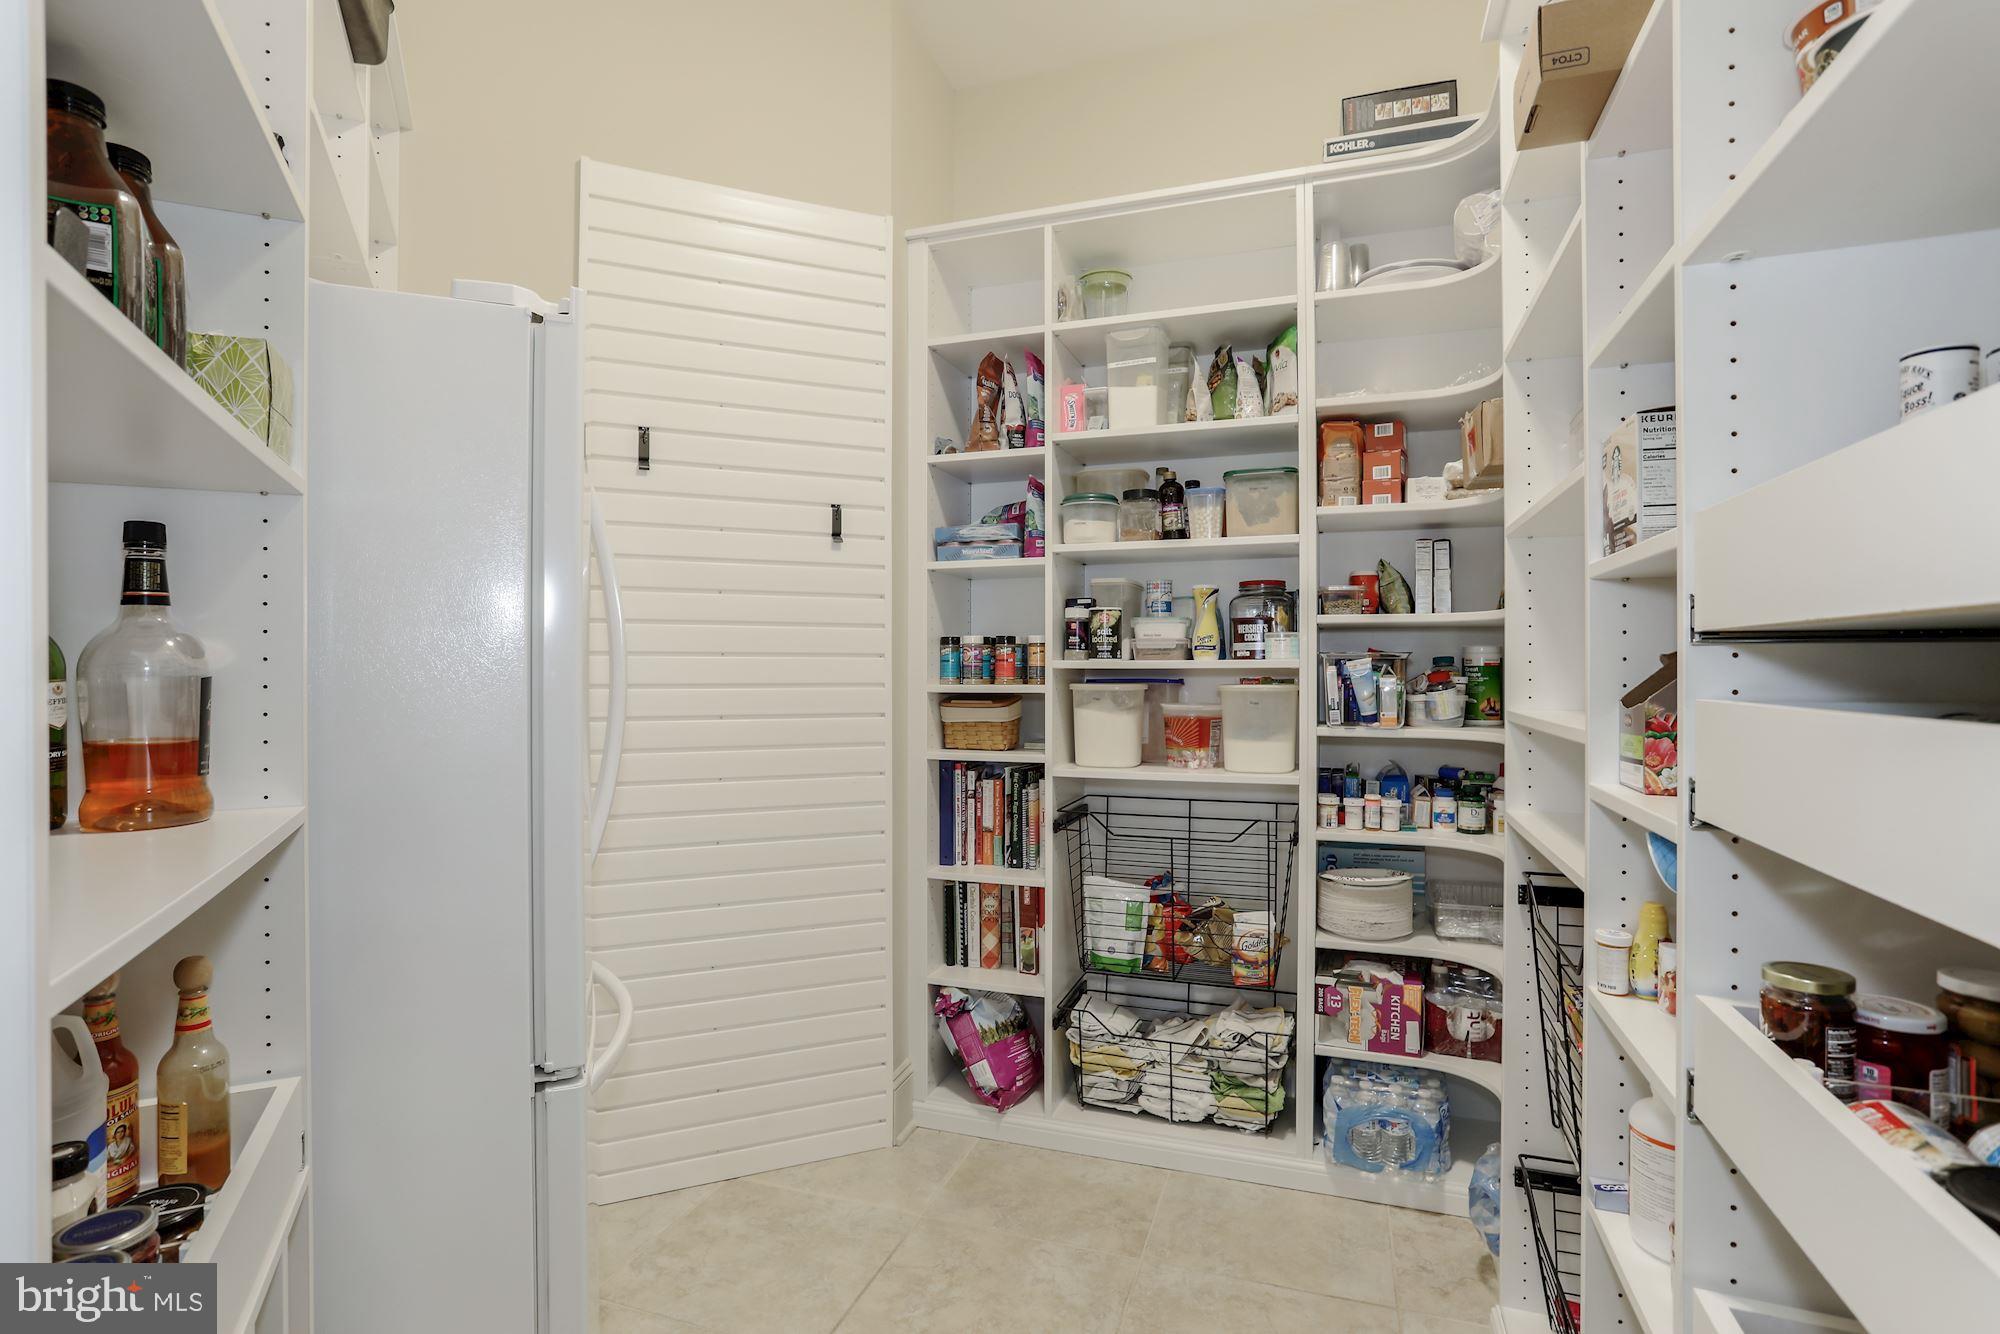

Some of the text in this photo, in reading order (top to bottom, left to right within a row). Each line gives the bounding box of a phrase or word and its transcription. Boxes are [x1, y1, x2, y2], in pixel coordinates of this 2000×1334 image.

[1329, 139, 1369, 154] KOHLER
[1096, 627, 1112, 636] salt
[1236, 623, 1269, 634] HERSHEY'S
[1092, 635, 1117, 643] iodized
[1241, 938, 1268, 952] Goldfis
[1330, 994, 1342, 1009] 13
[1390, 995, 1400, 1040] KITCHEN
